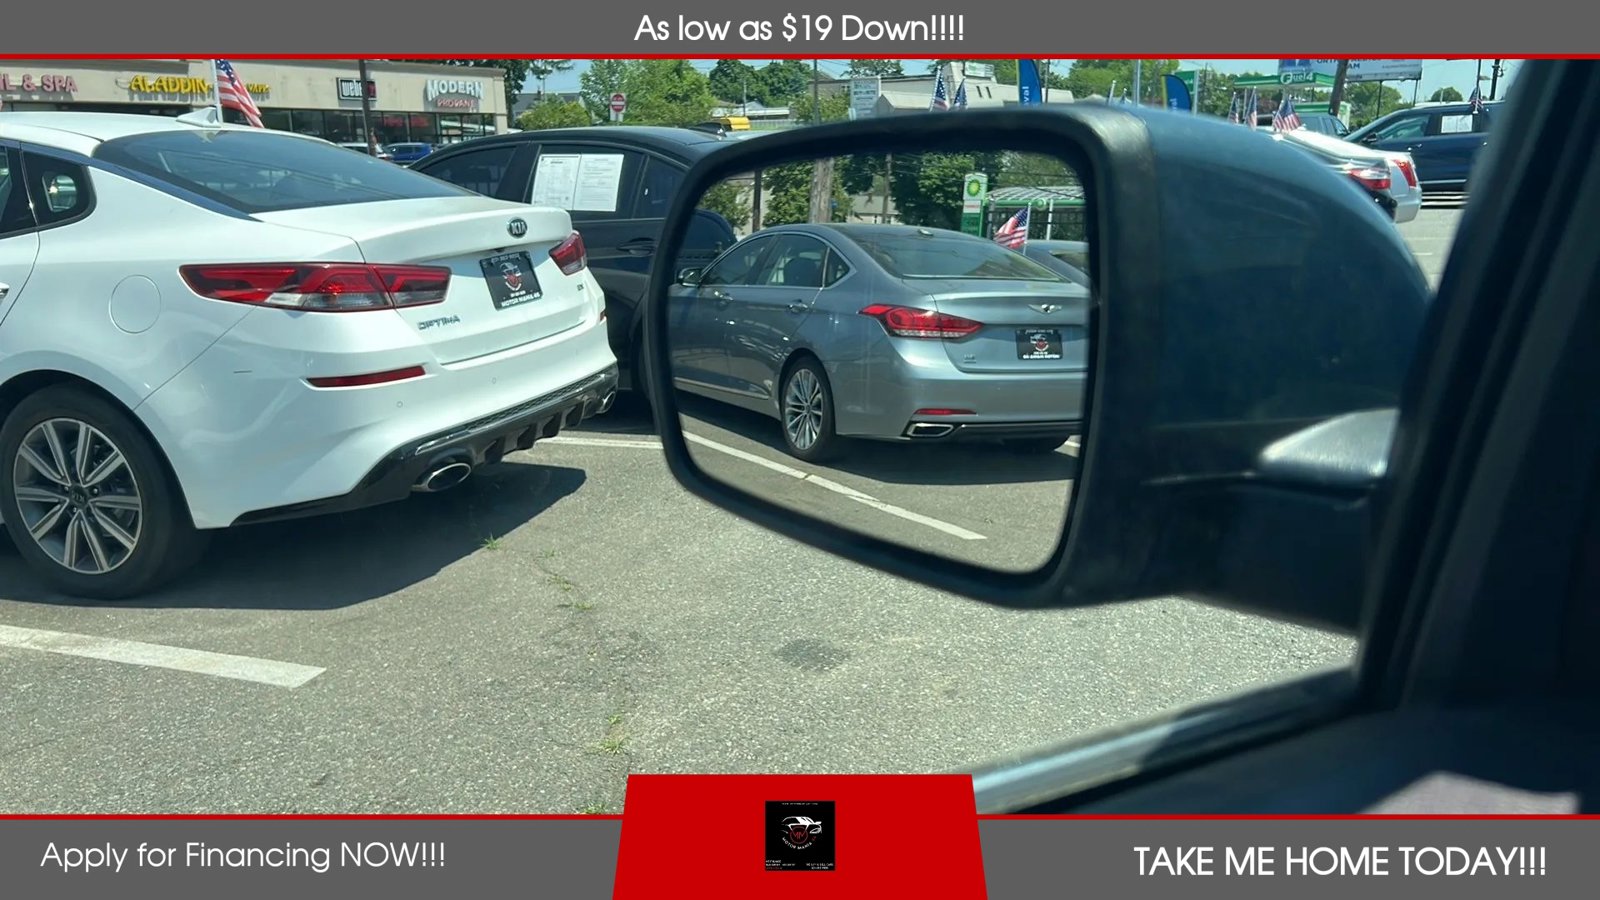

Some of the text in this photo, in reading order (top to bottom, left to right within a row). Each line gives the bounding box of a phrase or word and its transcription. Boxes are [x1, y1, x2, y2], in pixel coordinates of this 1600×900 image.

[22, 73, 37, 91] &
[41, 74, 78, 92] SPA
[130, 74, 209, 93] ALADDIN
[427, 79, 484, 101] MODERN
[416, 314, 461, 331] OPTIMA
